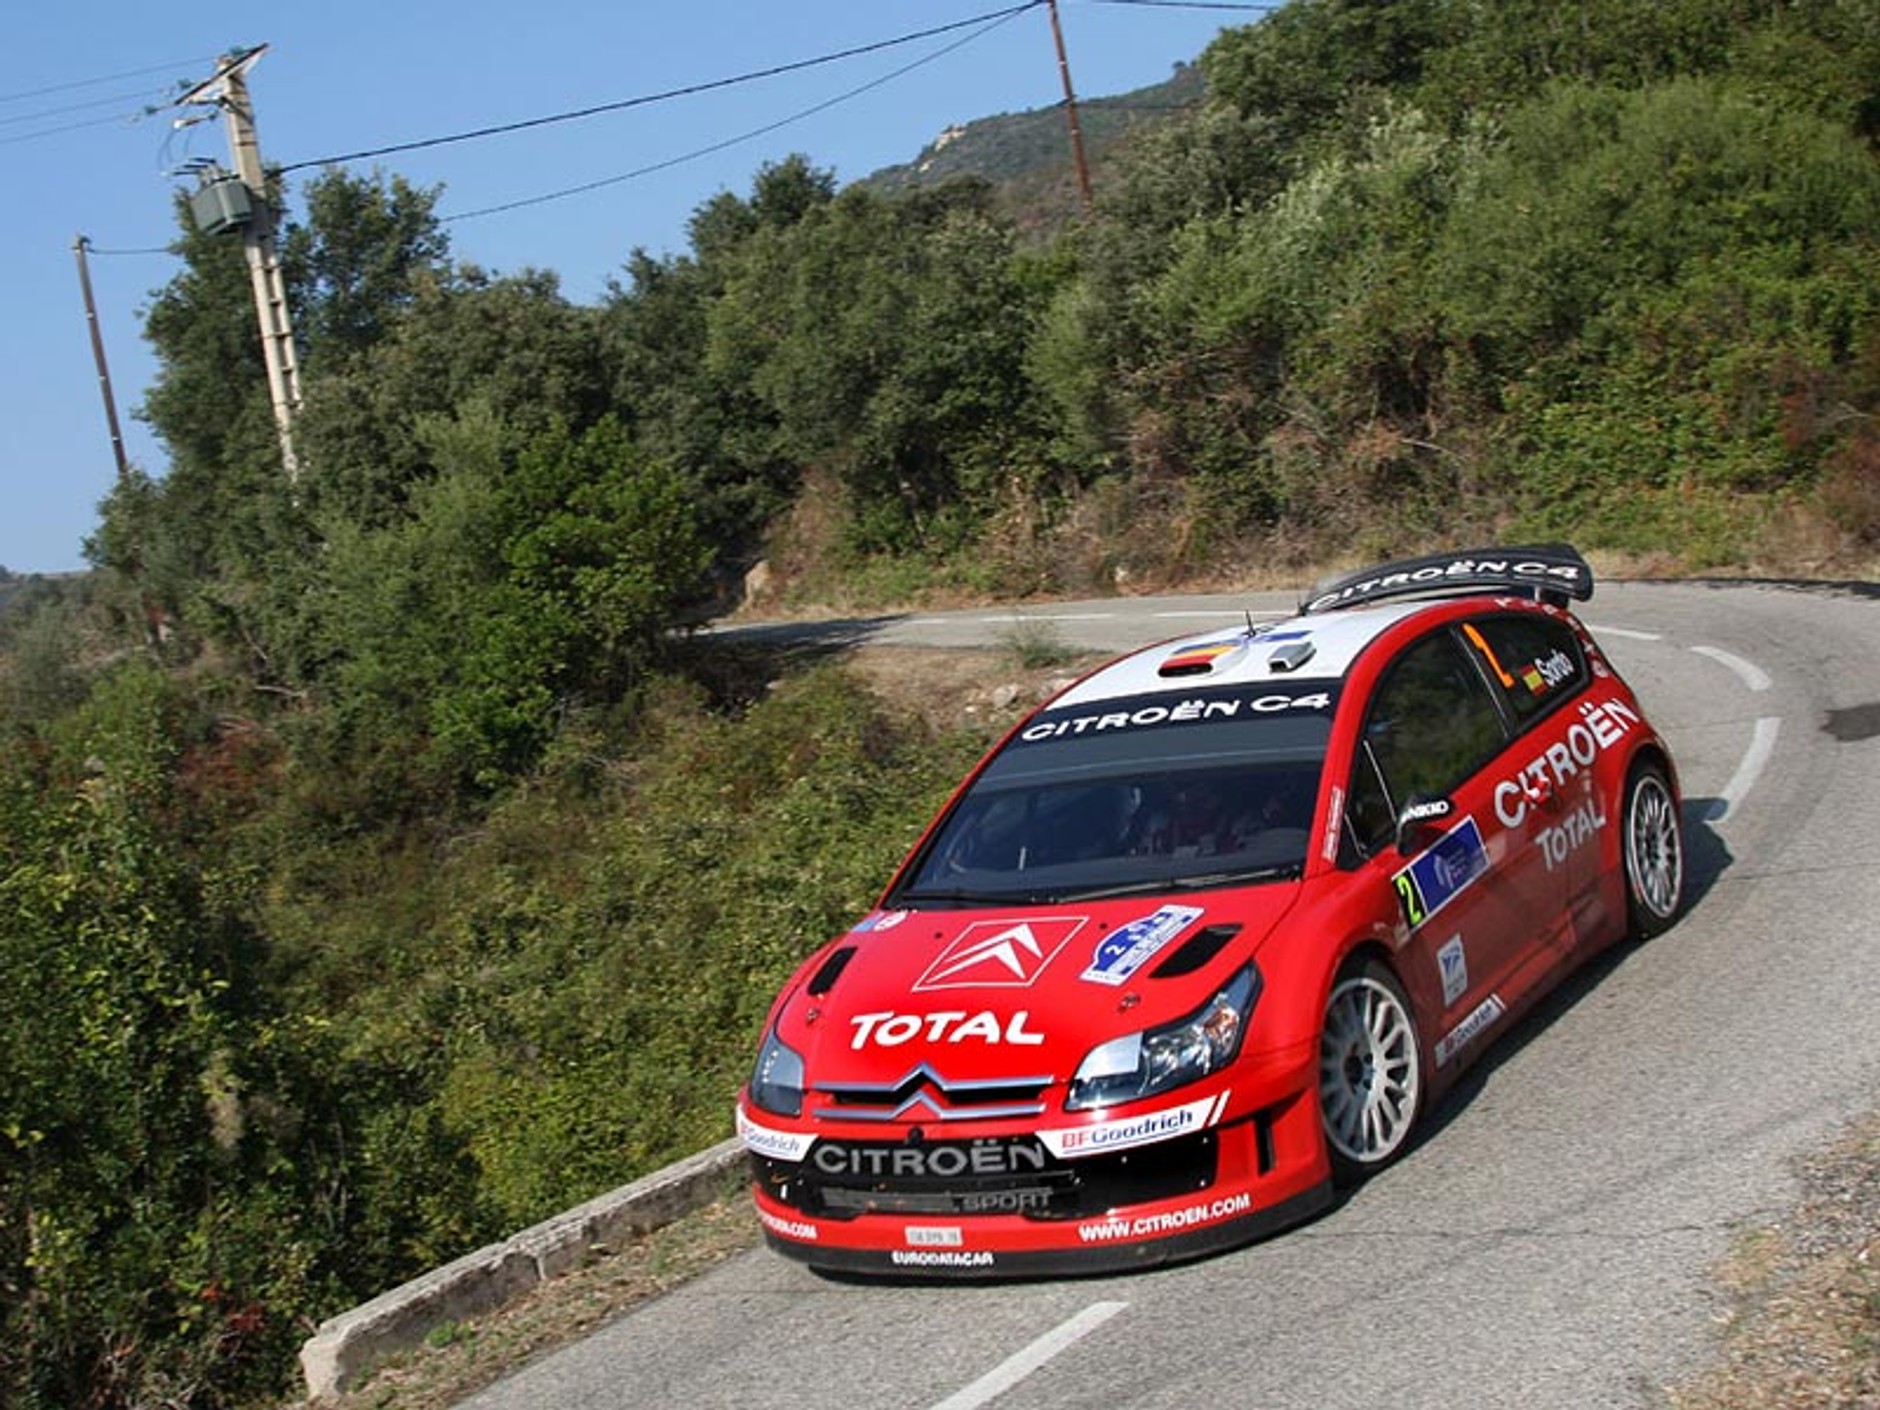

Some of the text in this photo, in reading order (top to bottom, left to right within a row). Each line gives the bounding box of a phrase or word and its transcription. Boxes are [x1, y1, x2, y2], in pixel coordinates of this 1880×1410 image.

[1308, 560, 1579, 610] CITROËN C4
[1021, 693, 1330, 741] CITROËN C4
[1535, 798, 1606, 871] TOTAL
[1396, 874, 1421, 925] 2
[850, 1010, 1044, 1050] TOTAL
[1061, 1108, 1193, 1149] BFGoodrich
[814, 1139, 1045, 1175] CITROËN
[1078, 1193, 1250, 1242] WWW.CITROEN.COM
